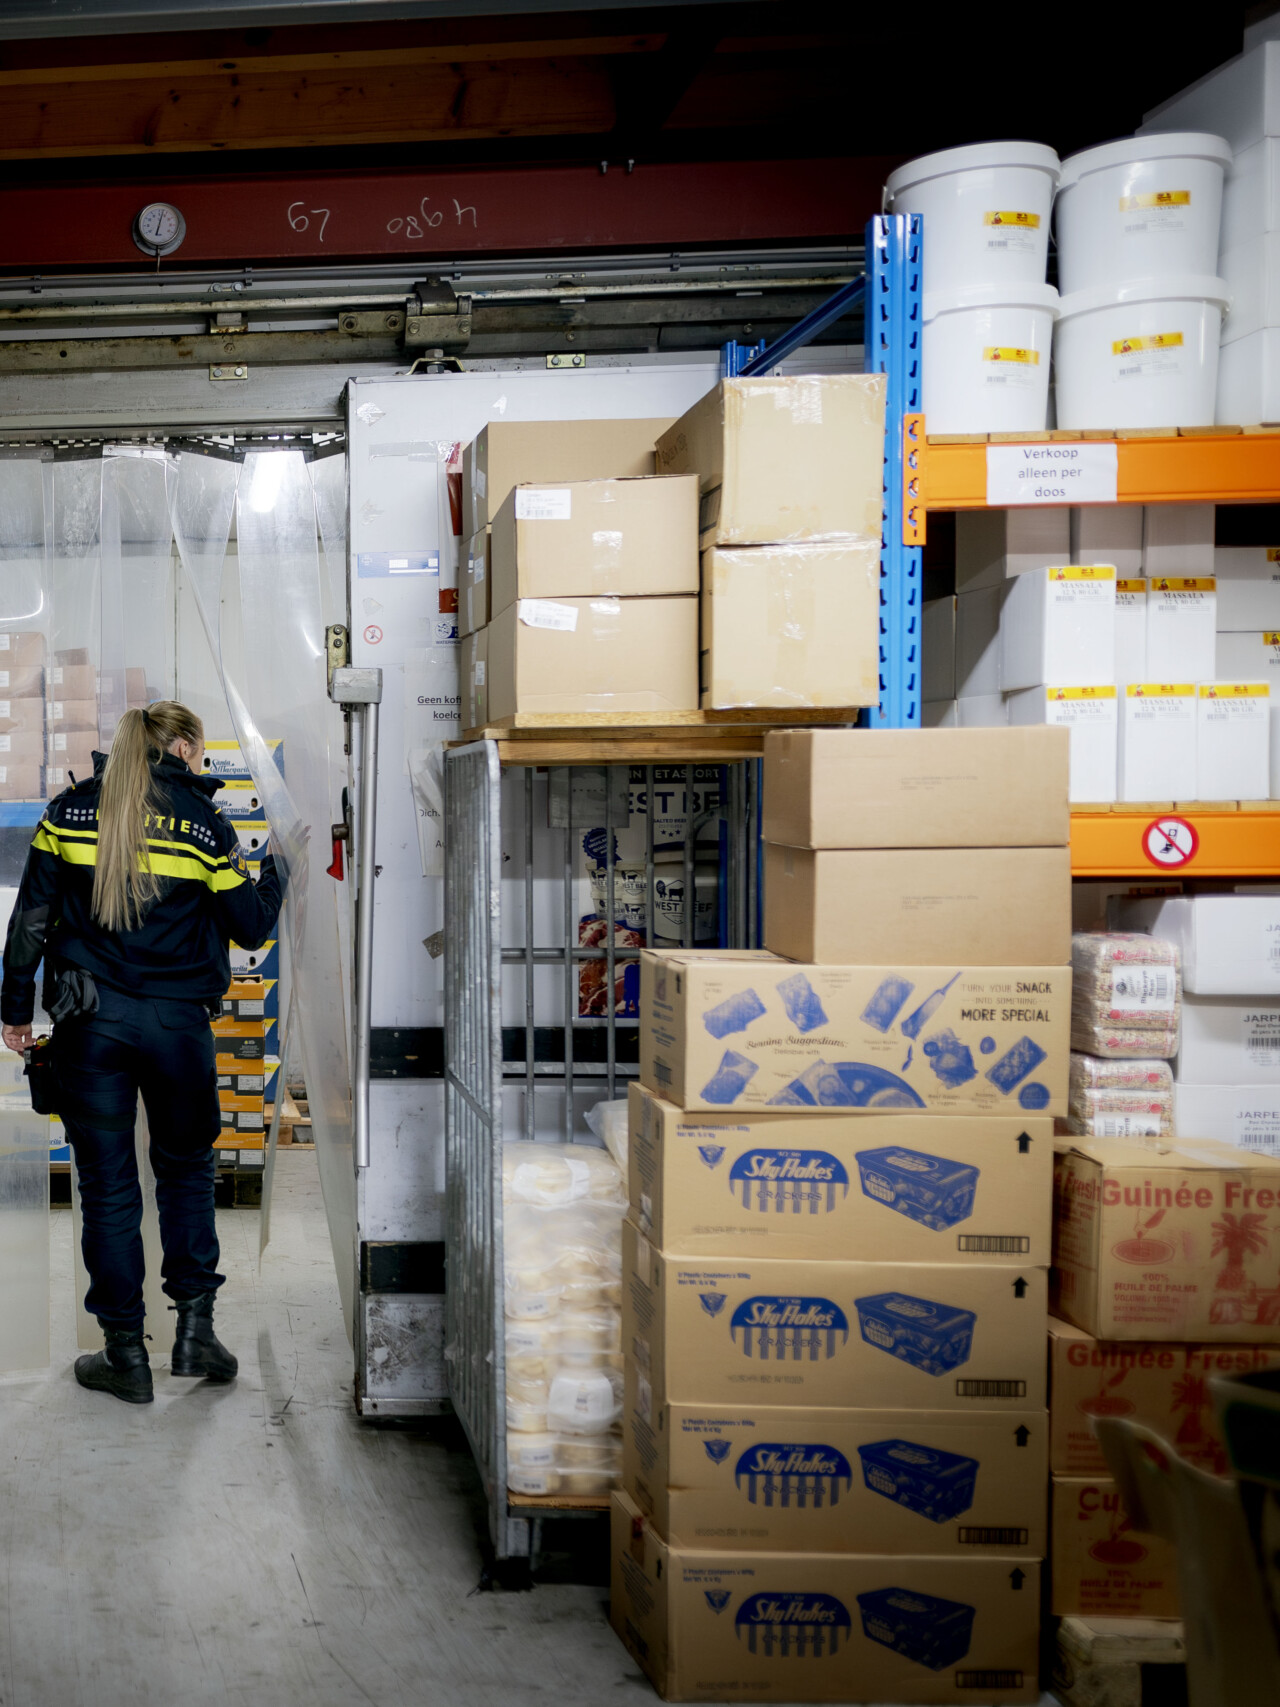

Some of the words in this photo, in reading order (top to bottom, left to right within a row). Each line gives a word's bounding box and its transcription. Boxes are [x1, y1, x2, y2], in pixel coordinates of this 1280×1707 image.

[1023, 447, 1079, 461] Verkoop
[1018, 467, 1056, 480] alleen
[1060, 467, 1083, 480] per
[1034, 485, 1066, 498] doos
[417, 695, 442, 704] Geen
[655, 769, 670, 779] ET
[629, 791, 675, 814] EST
[221, 806, 250, 814] argarita
[420, 808, 441, 817] Dich
[655, 902, 679, 912] WEST
[682, 902, 712, 912] EEF
[961, 983, 985, 993] TURN
[990, 983, 1012, 993] YOUR
[1016, 981, 1053, 994] SNACK
[961, 1008, 997, 1022] MORE
[1001, 1008, 1052, 1022] SPECIAL
[1236, 1111, 1280, 1120] JARPE
[744, 1154, 834, 1180] SkyFlakes
[756, 1190, 823, 1201] CRACKERS
[1102, 1179, 1214, 1209] Guinée
[1224, 1181, 1280, 1209] Fres
[1142, 1273, 1169, 1282] 100%
[1114, 1282, 1145, 1292] HUILE
[1149, 1284, 1163, 1292] DE
[1165, 1284, 1199, 1293] PALME
[744, 1301, 834, 1327] SkyFlakes
[757, 1338, 823, 1348] CRACKERS
[1067, 1343, 1175, 1370] Guinée
[1184, 1346, 1271, 1371] Fresh
[750, 1449, 838, 1474] SkyFlakes
[762, 1485, 826, 1496] CRACKERS
[750, 1599, 837, 1624] SkyFlakes
[762, 1635, 826, 1645] CRACKERS
